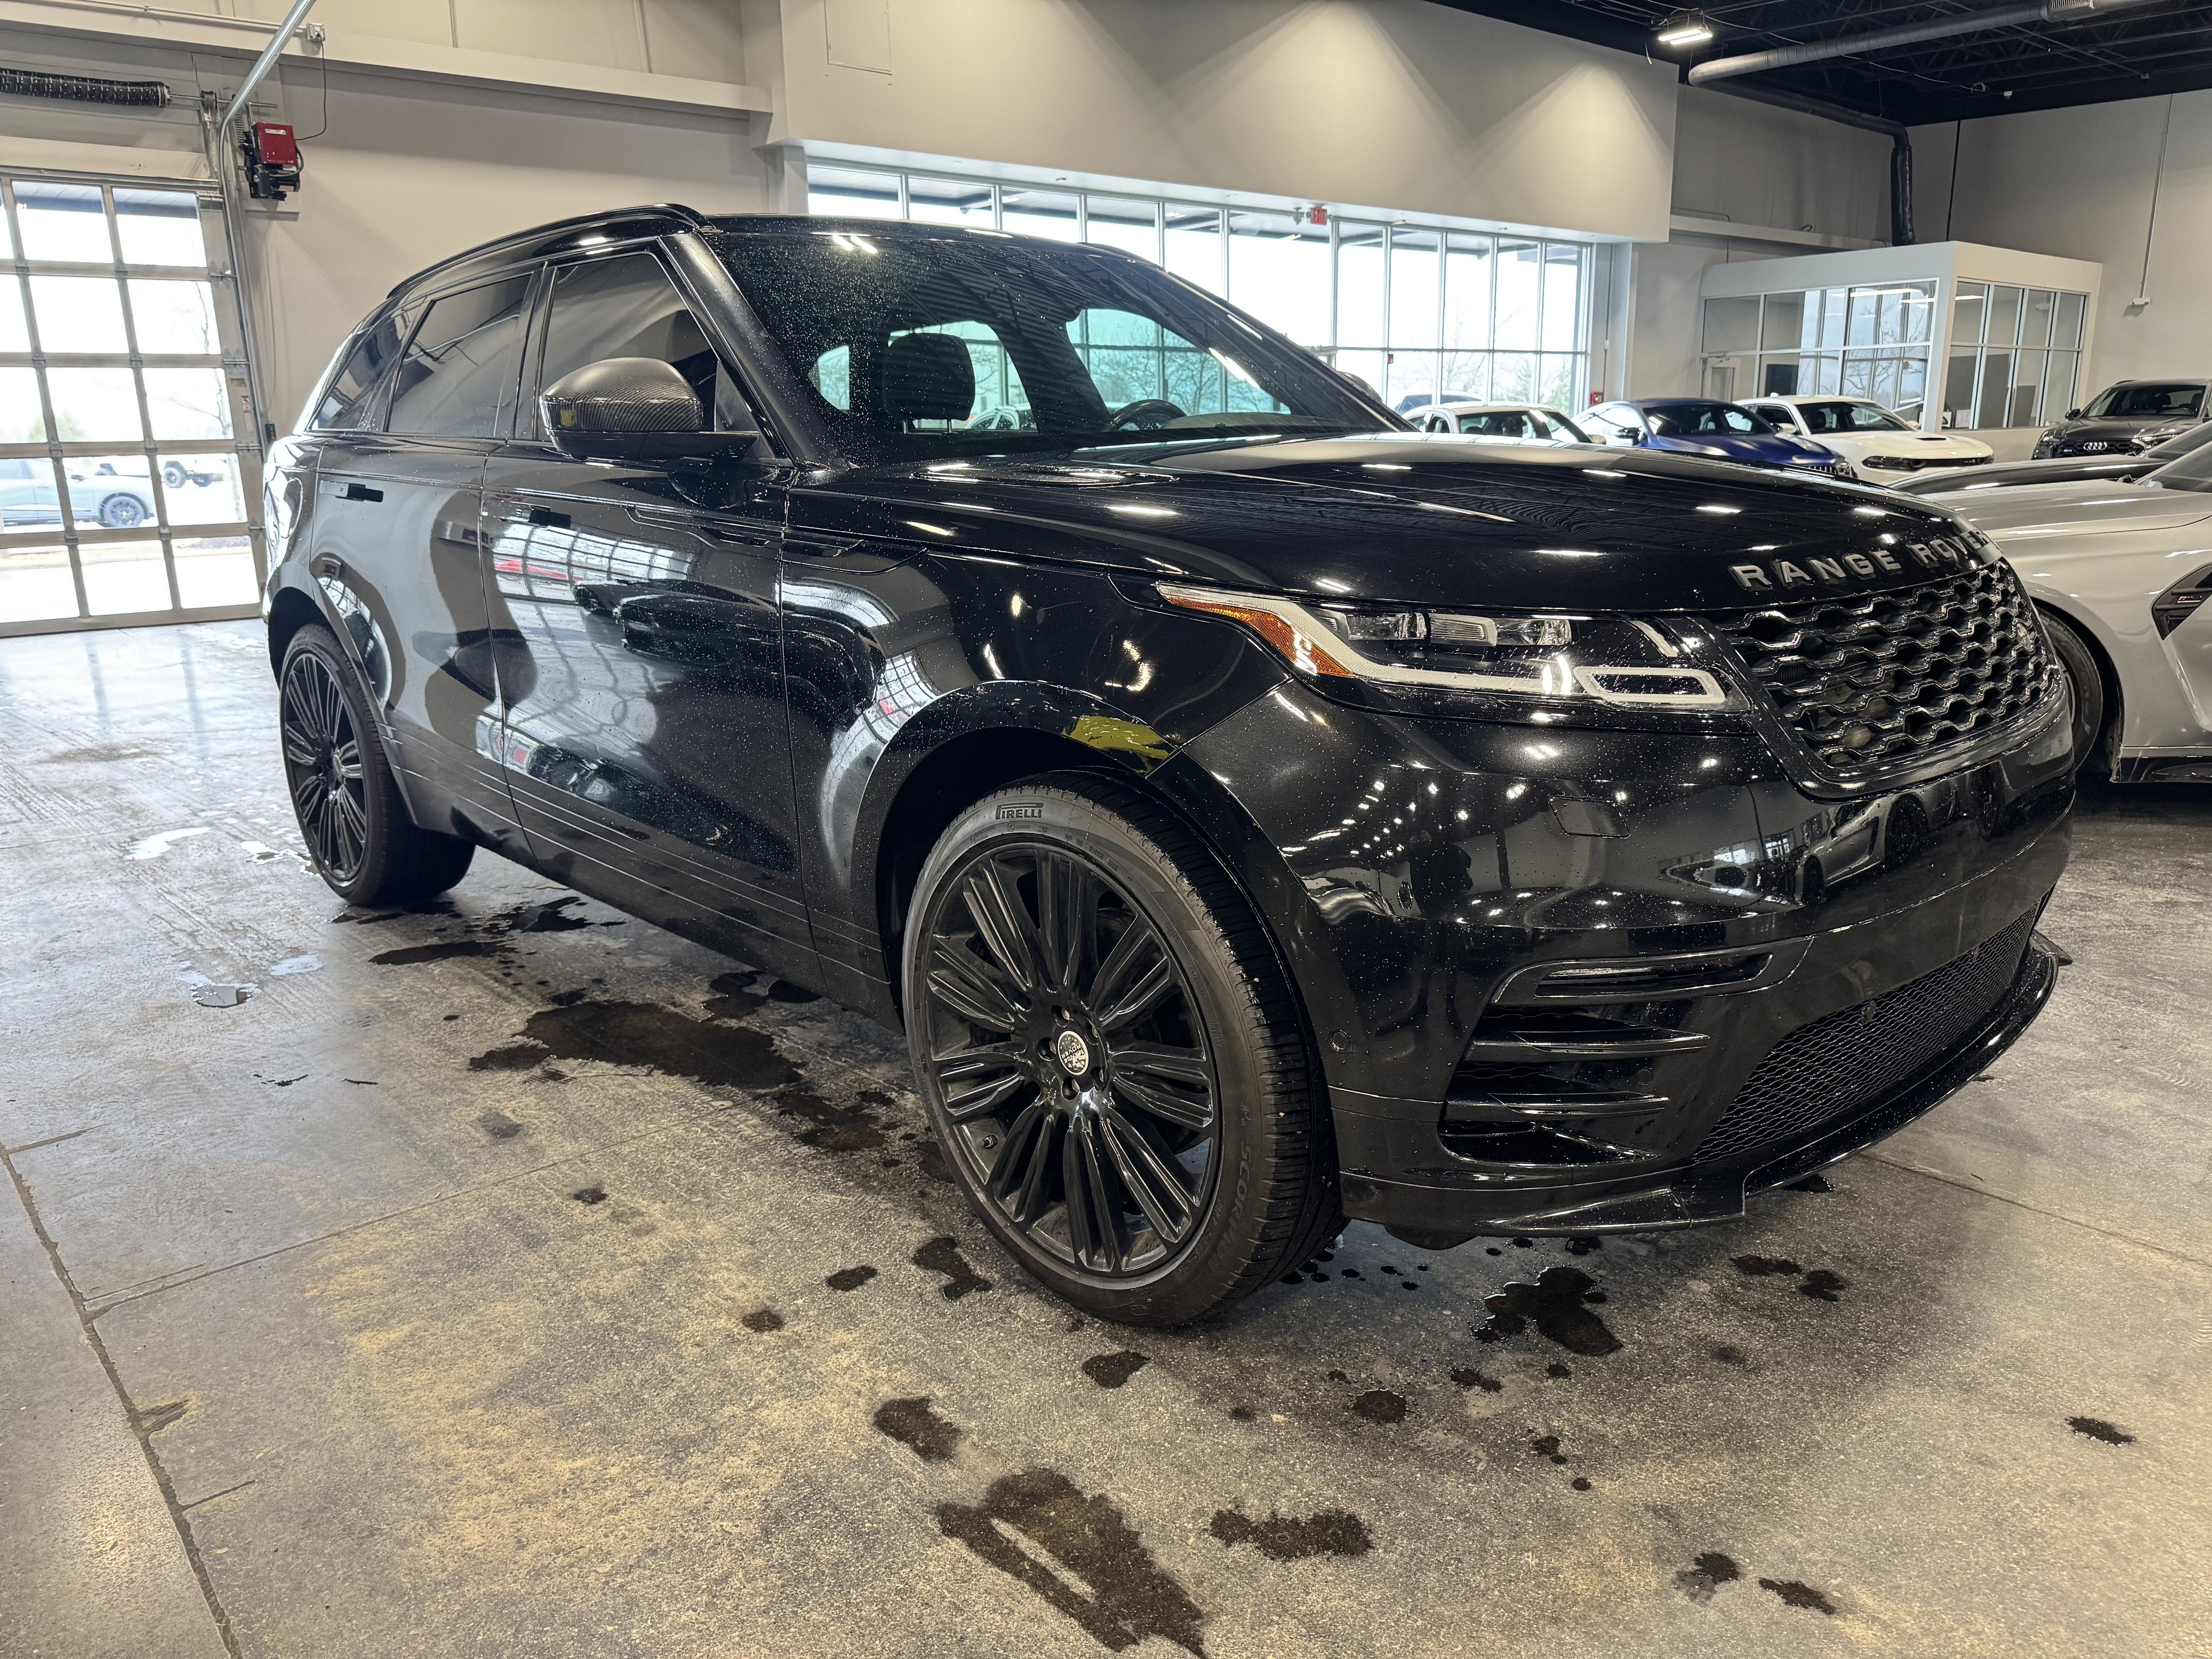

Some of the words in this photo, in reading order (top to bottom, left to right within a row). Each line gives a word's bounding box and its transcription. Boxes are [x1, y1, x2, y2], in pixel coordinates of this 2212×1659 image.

[1732, 550, 1901, 589] RANGE
[1909, 530, 1990, 564] ROVER
[995, 803, 1044, 820] PIRELLI
[1061, 1043, 1081, 1058] ROVER
[1064, 1049, 1085, 1063] RANGE
